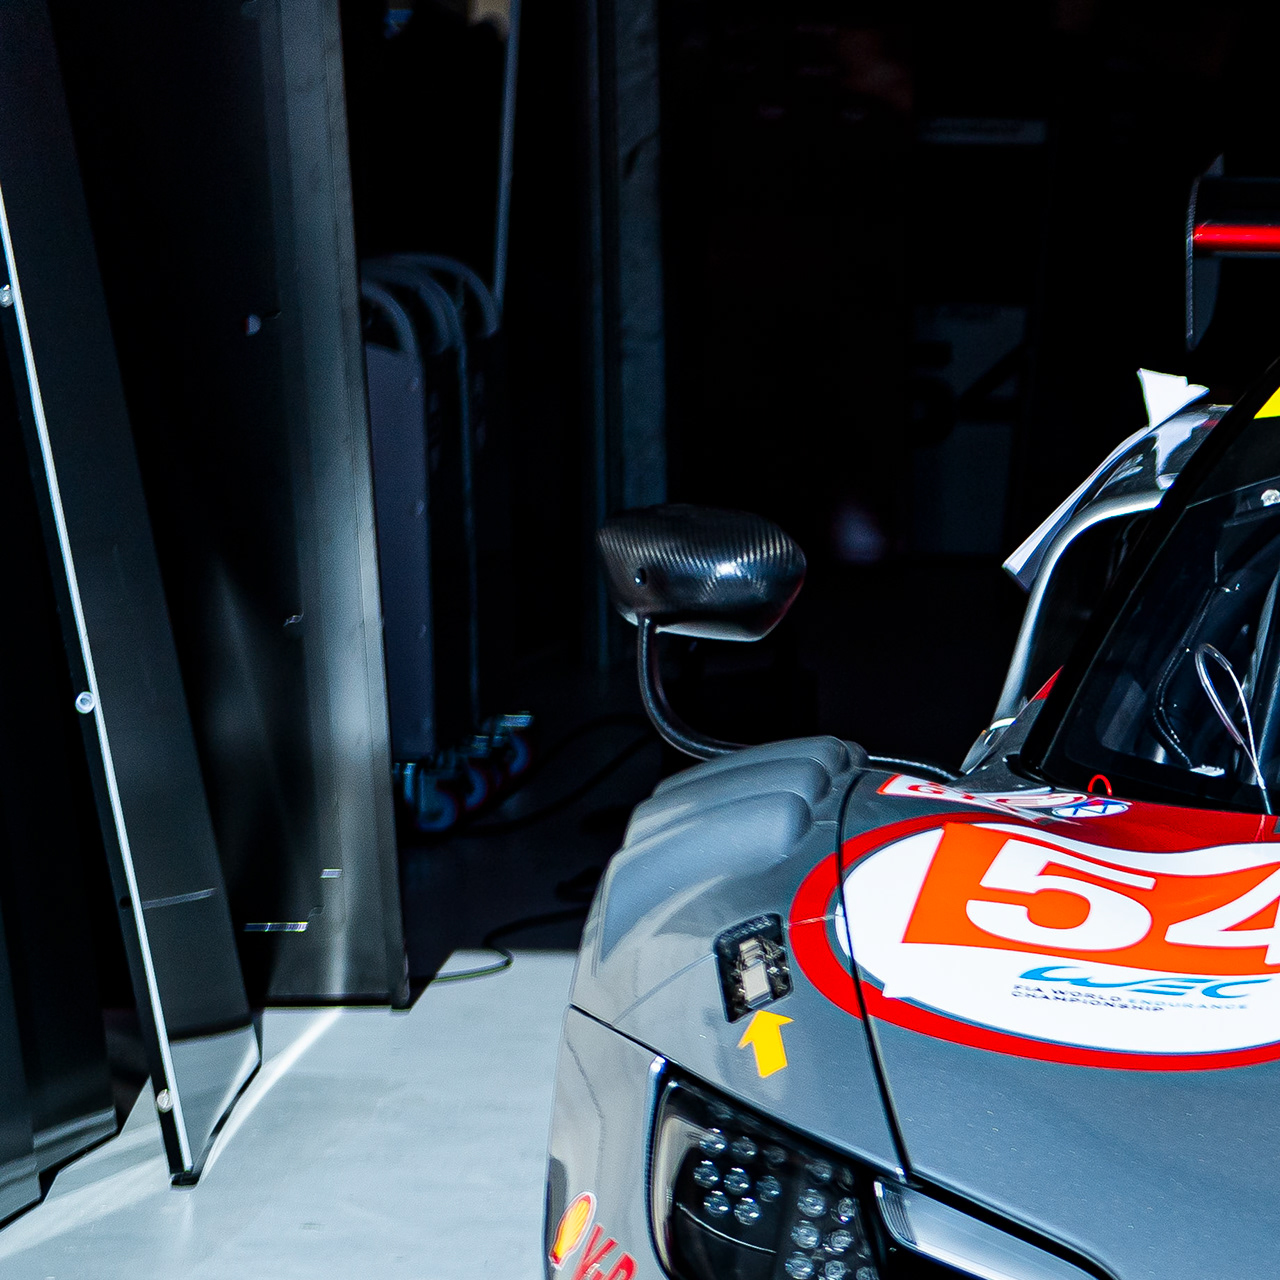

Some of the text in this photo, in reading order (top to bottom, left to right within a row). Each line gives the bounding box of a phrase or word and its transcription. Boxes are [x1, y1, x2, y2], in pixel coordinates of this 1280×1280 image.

[1018, 965, 1273, 999] WEC
[1011, 991, 1165, 1012] CHAMPIONSHIP
[1013, 984, 1248, 1010] FIA WORLD ENDURANCE
